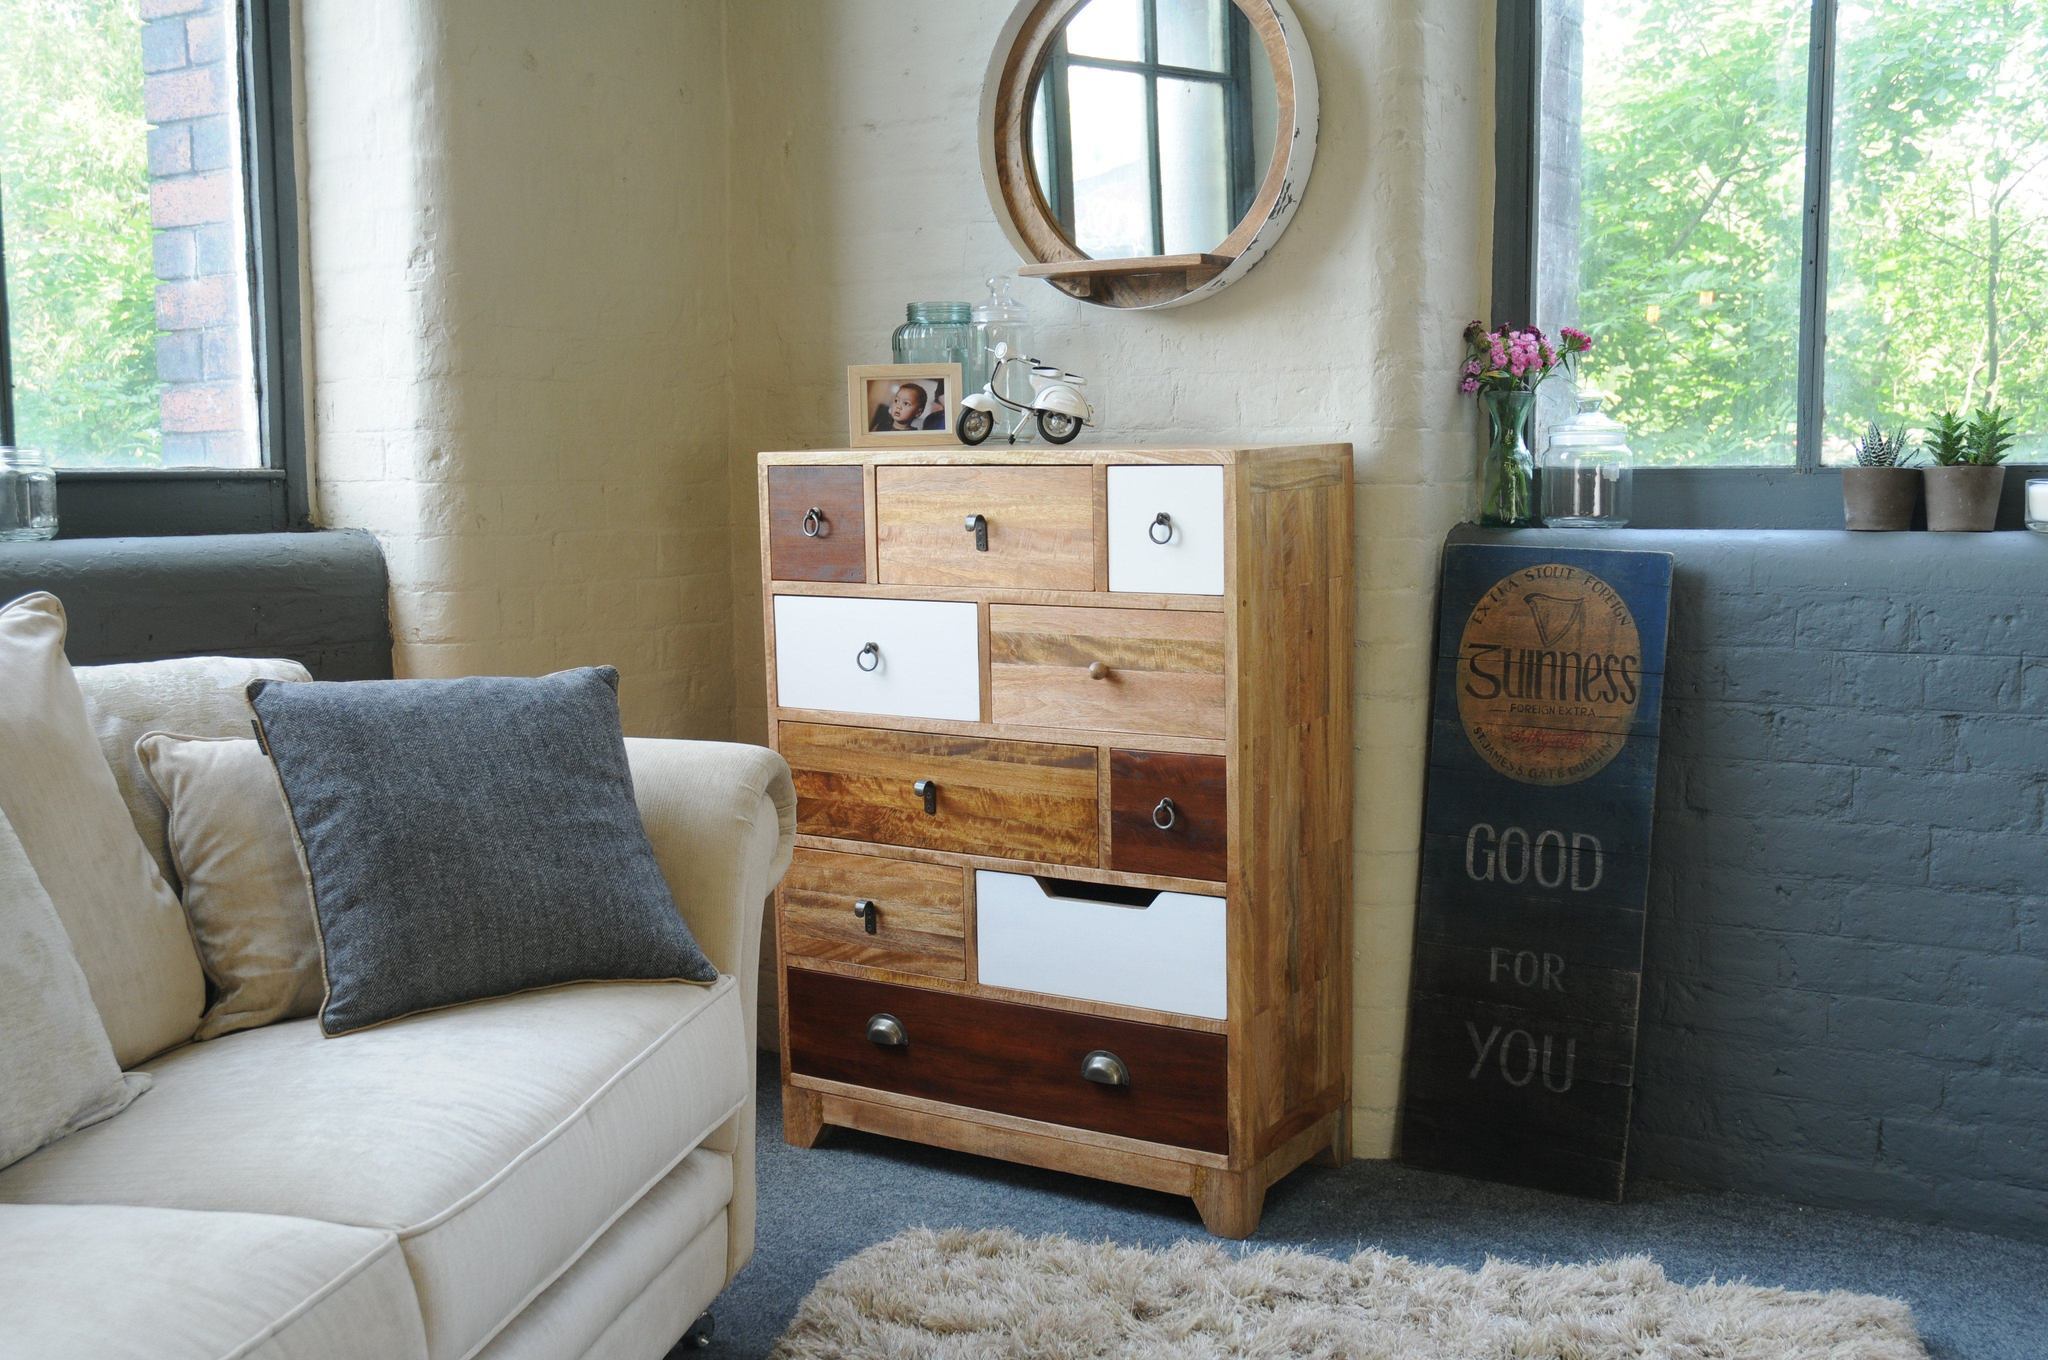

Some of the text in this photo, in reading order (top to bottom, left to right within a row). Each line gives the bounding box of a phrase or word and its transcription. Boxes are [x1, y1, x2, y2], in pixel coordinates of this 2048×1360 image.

[1472, 566, 1633, 626] EXTRA STOUT FOREIGN
[1510, 703, 1596, 717] FOREIGN EXTRA
[1466, 823, 1603, 891] GOOD
[1490, 947, 1567, 993] FOR
[1465, 1021, 1577, 1093] YOU
